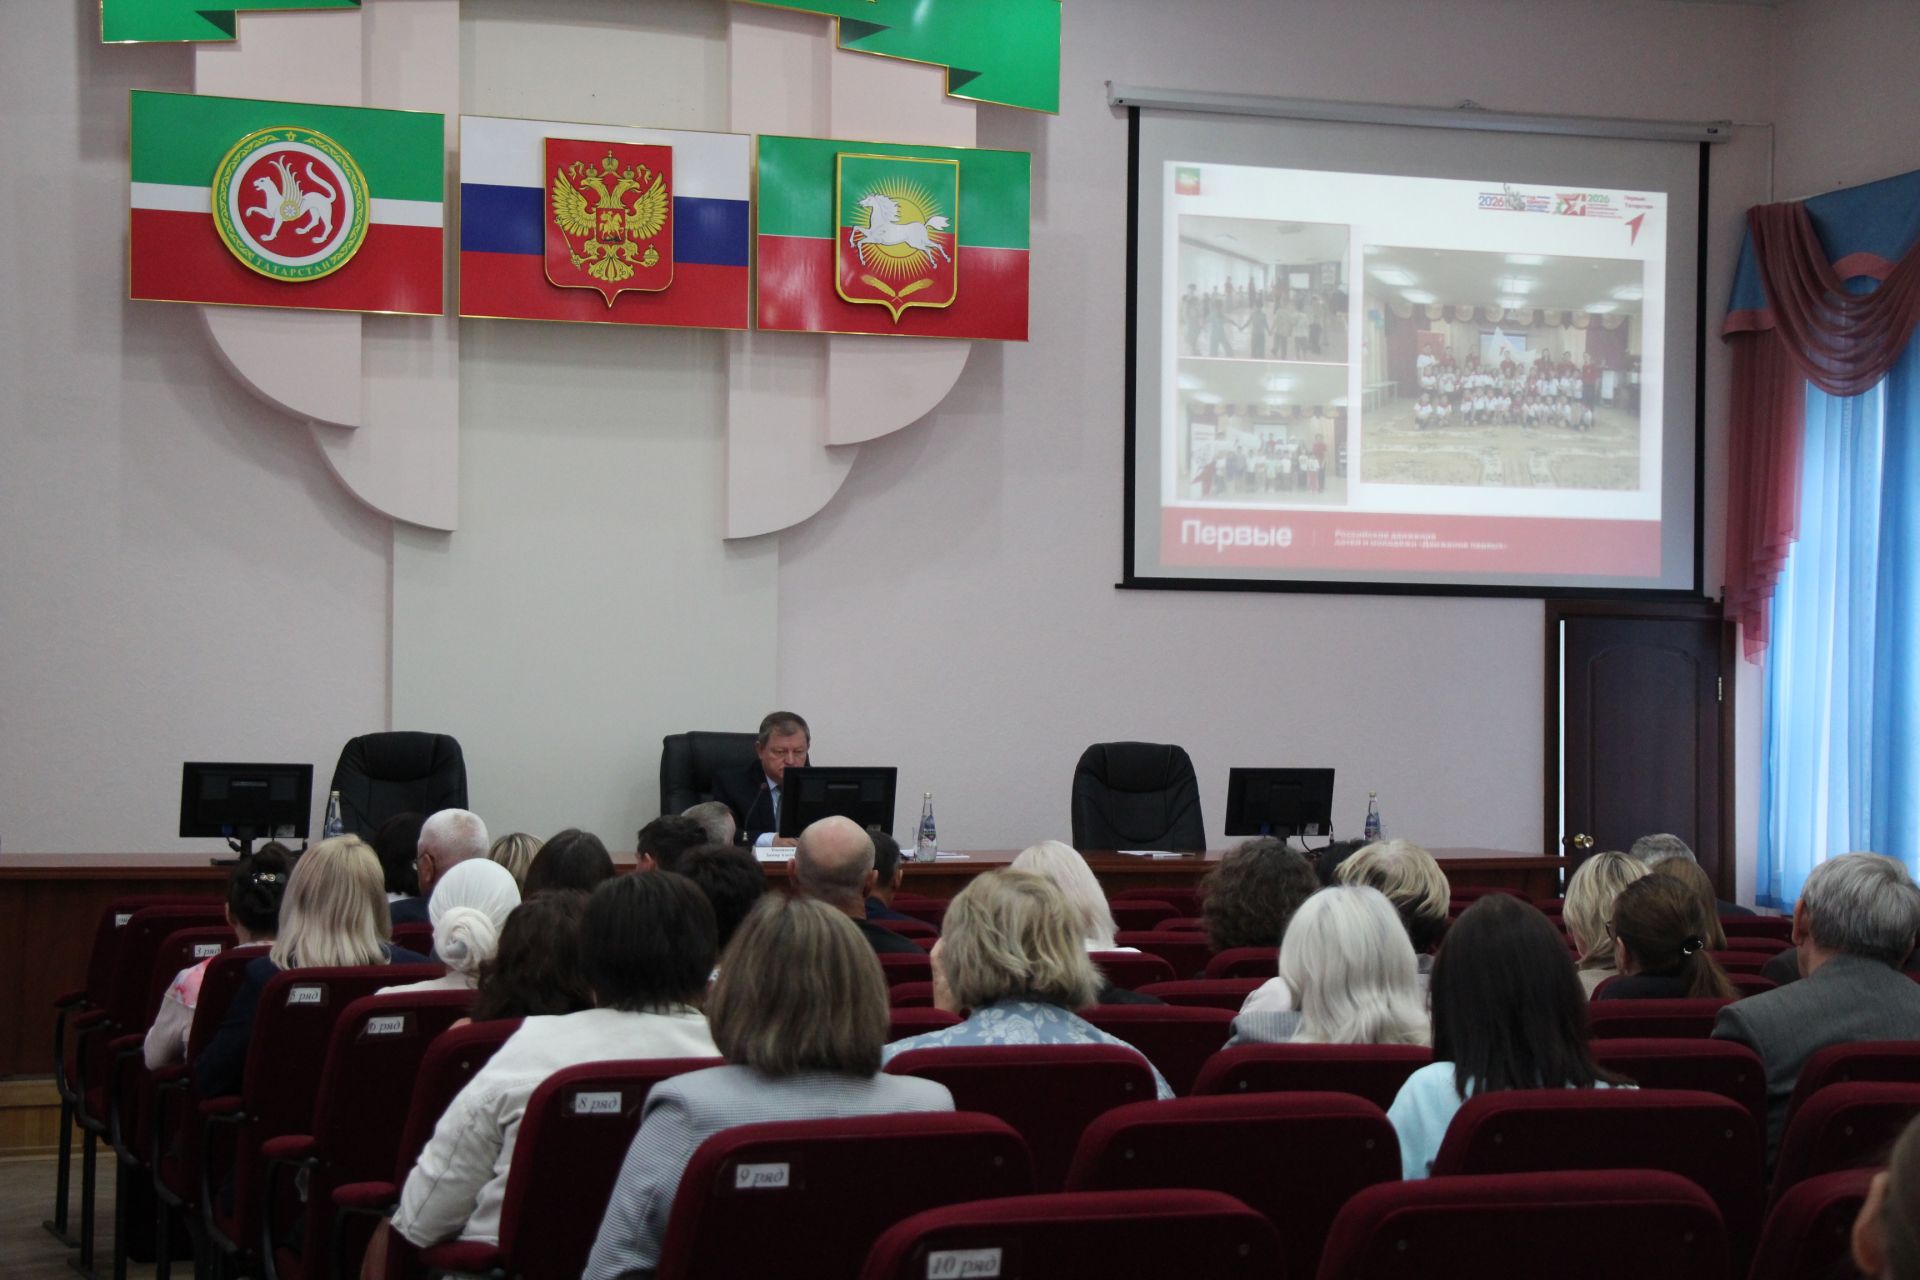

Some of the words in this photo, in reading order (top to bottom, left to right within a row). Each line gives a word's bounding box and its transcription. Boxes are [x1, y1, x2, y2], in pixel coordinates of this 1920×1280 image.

[1478, 195, 1505, 208] 2026
[256, 258, 331, 277] ТАТАРСТАН
[1181, 519, 1293, 553] Первые
[298, 990, 319, 1003] ряд
[368, 1021, 377, 1031] 6
[378, 1020, 401, 1034] ряд
[577, 1097, 588, 1110] 8
[590, 1096, 618, 1113] ряд
[740, 1168, 751, 1182] 9
[752, 1167, 785, 1186] ряд
[932, 1255, 957, 1275] 10
[959, 1254, 998, 1277] ряд
